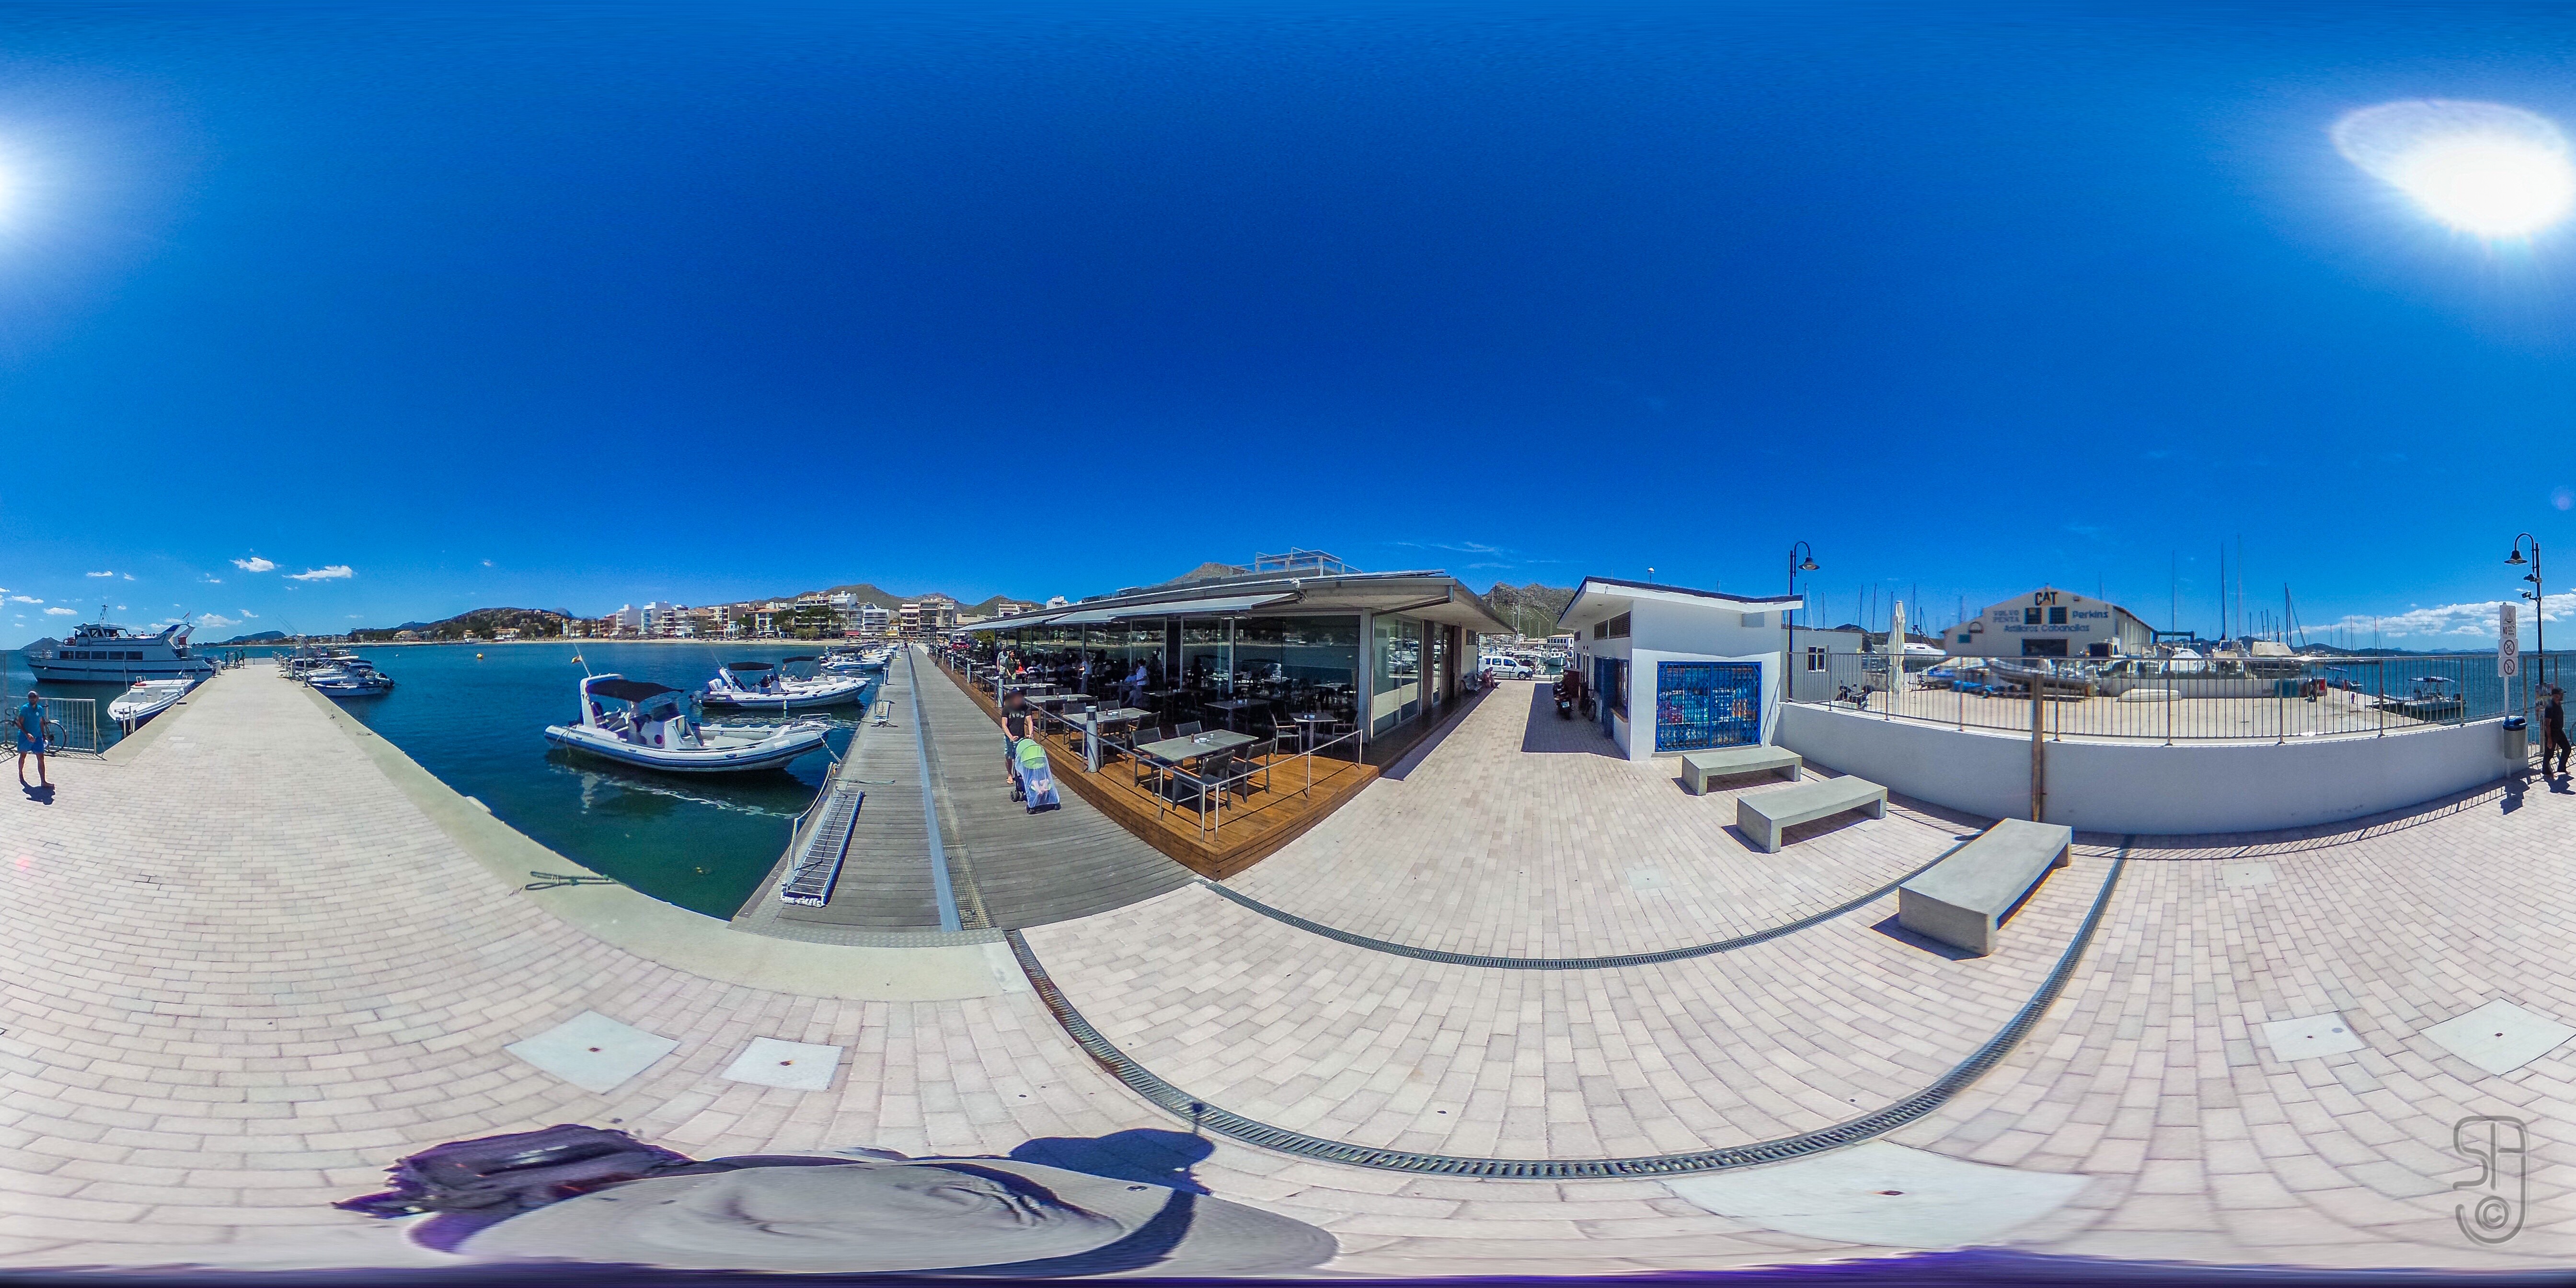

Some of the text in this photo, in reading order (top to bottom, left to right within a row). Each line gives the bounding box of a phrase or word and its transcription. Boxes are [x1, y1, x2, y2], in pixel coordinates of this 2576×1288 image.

[2035, 591, 2058, 606] CAT
[2072, 610, 2109, 619] Perkins
[2503, 626, 2508, 635] NO
